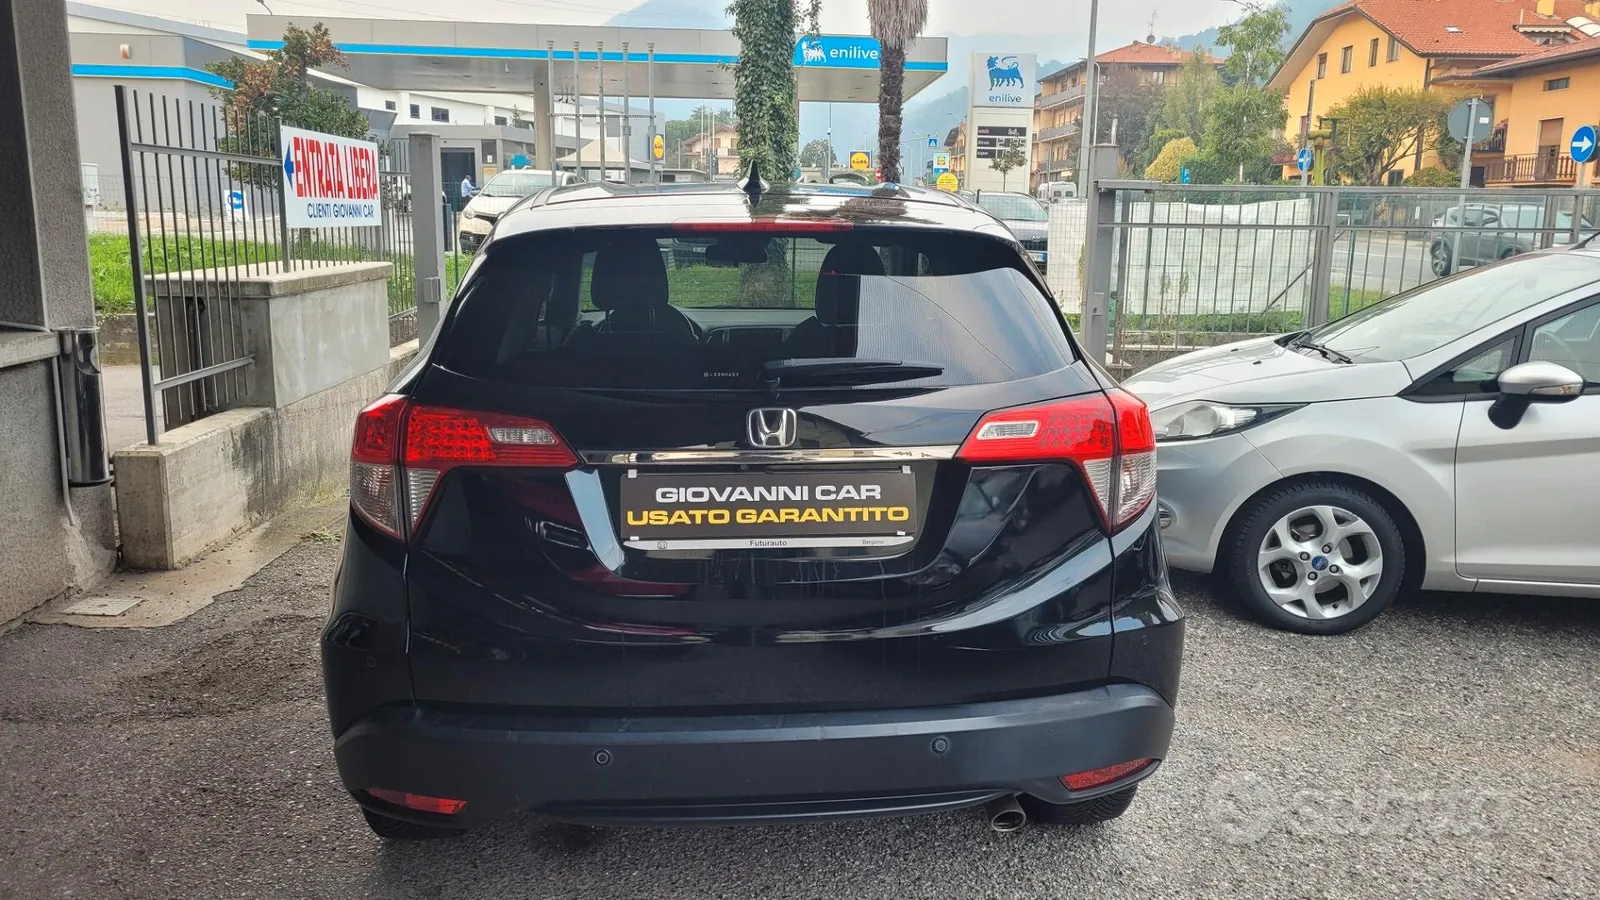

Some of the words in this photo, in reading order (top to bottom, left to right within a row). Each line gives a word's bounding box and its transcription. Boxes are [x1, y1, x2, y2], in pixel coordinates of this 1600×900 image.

[830, 45, 879, 60] enilive
[988, 93, 1022, 103] enilive
[293, 136, 346, 199] ENTRATA
[343, 145, 379, 200] LIBERA
[307, 203, 332, 218] CLIENTI
[333, 203, 362, 218] GIOVANNI
[363, 204, 375, 218] CAR
[655, 485, 809, 504] GIOVANNI
[814, 484, 882, 500] CAR
[626, 508, 731, 526] USATO
[735, 506, 910, 524] GARANTITO
[749, 539, 788, 548] Futurauto
